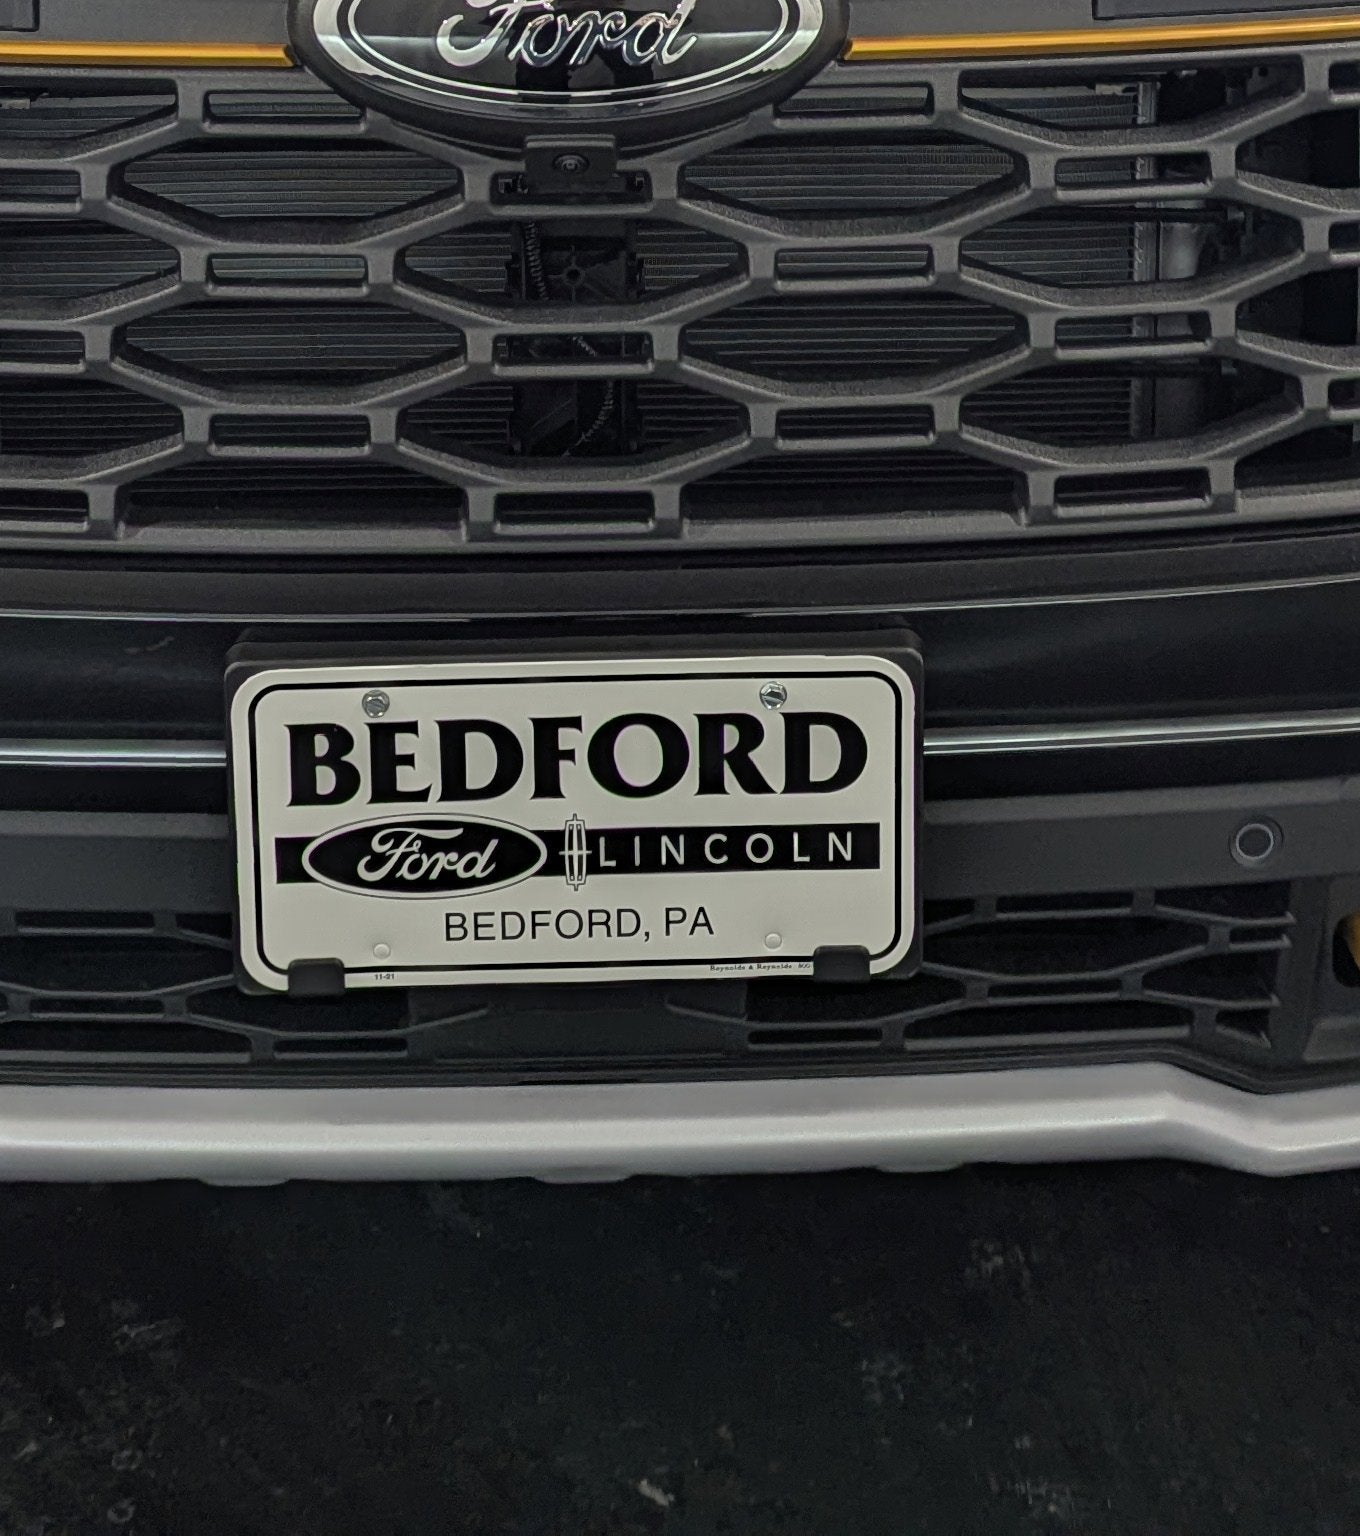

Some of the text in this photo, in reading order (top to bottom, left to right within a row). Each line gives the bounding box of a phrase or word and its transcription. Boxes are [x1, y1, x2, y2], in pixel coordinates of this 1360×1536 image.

[285, 712, 868, 807] BEDFORD
[356, 827, 497, 882] Ford
[598, 830, 853, 868] LINCOLN
[444, 906, 716, 944] BEDFORD, PA
